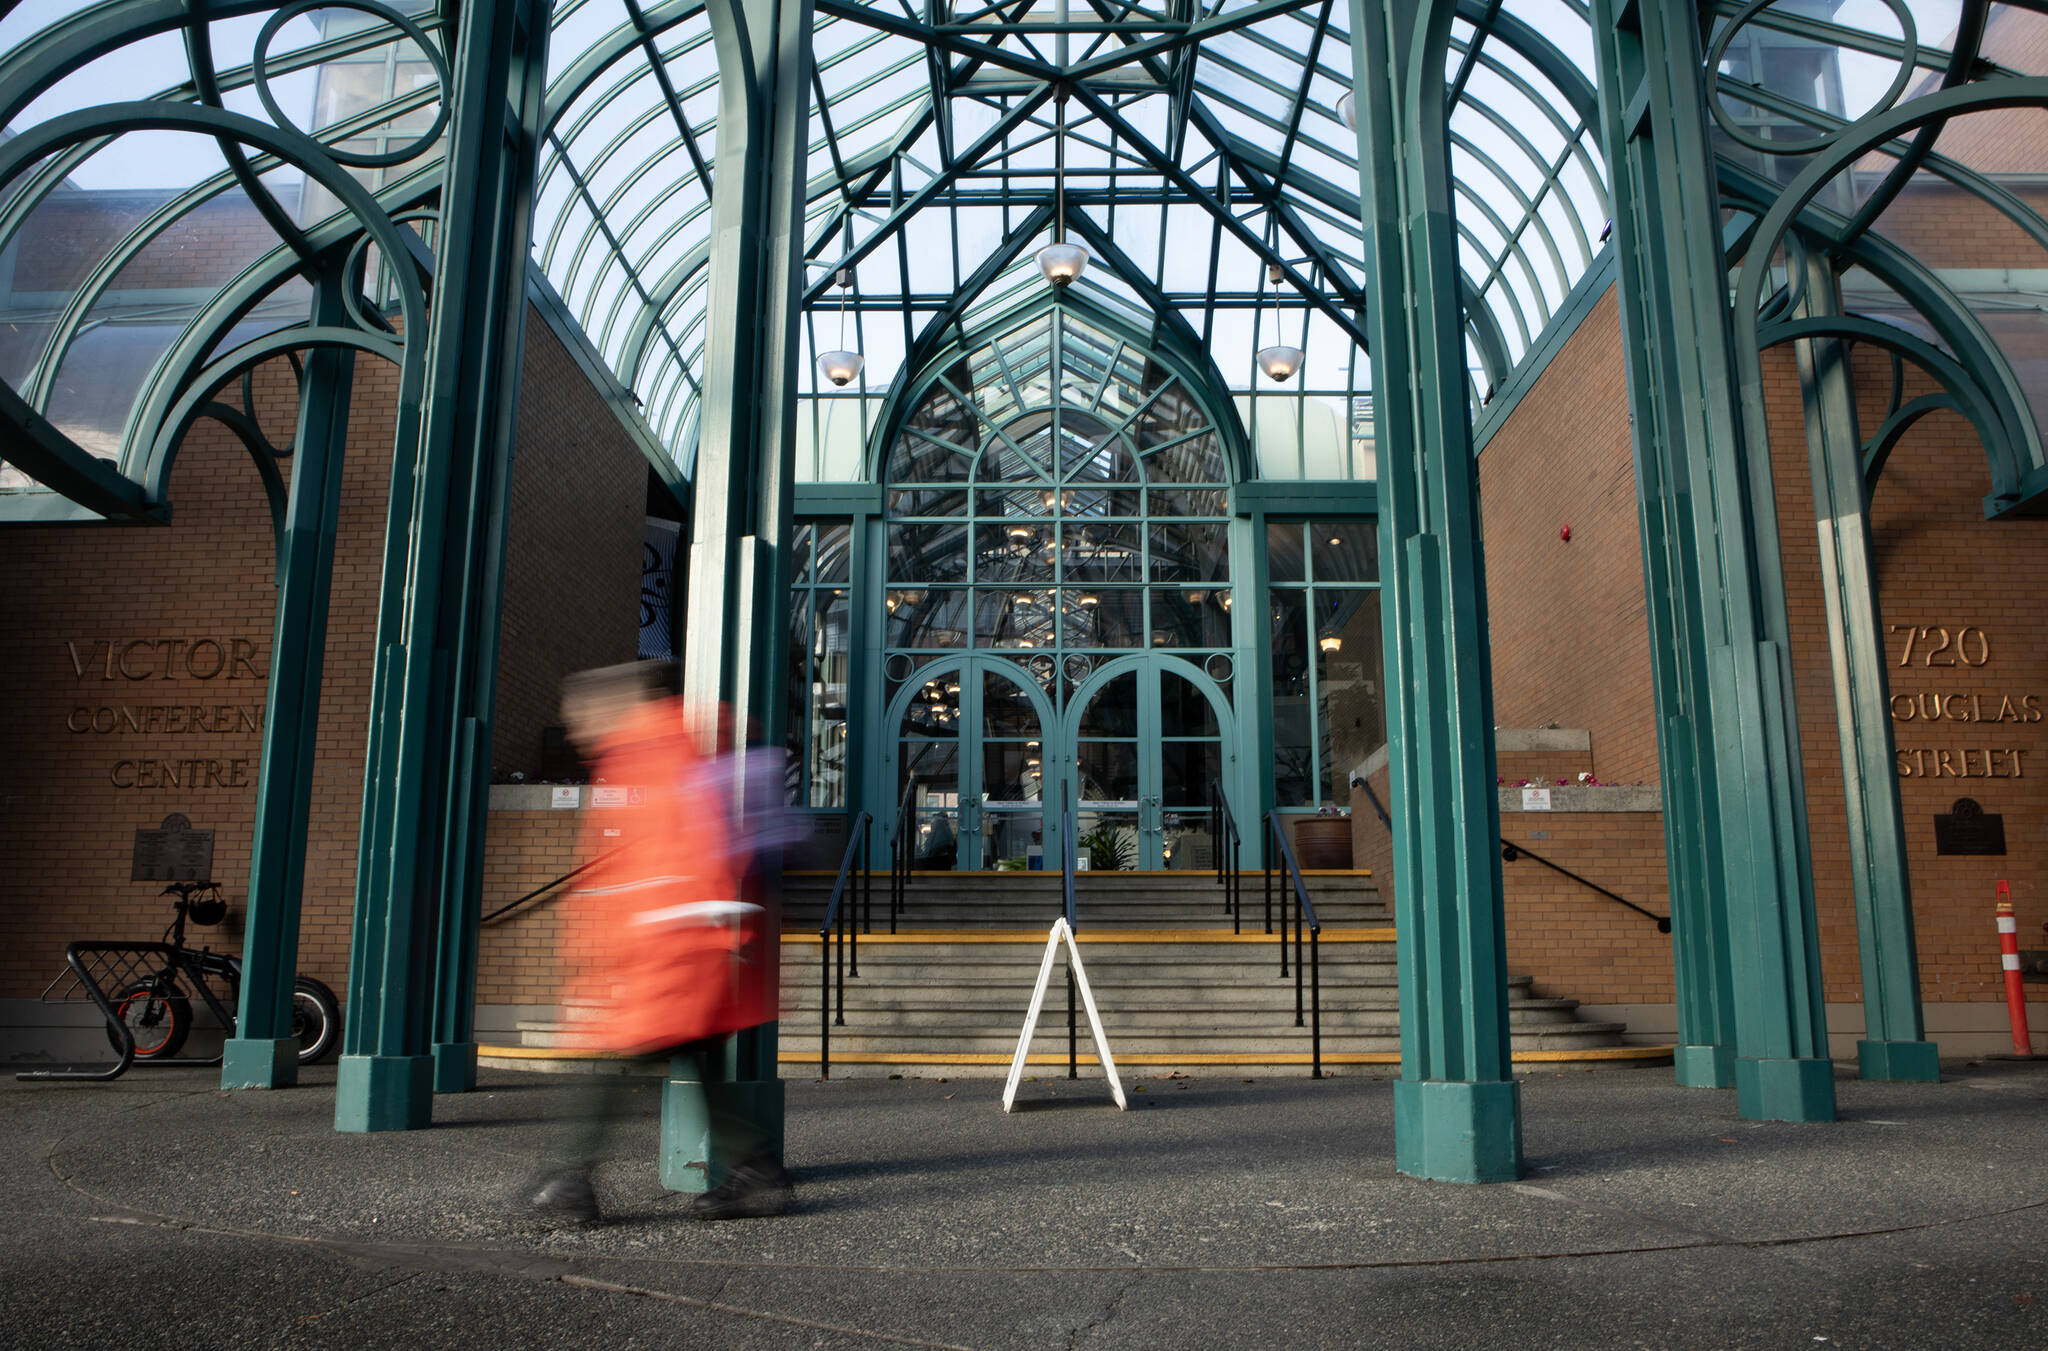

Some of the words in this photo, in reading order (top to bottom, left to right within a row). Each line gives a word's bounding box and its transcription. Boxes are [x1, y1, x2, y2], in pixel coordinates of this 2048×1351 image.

[66, 638, 269, 681] VICTOR
[1891, 625, 1990, 667] 720
[67, 706, 265, 734] CONFEREN
[1891, 694, 2043, 723] OUGLAS
[111, 759, 249, 788] CENTRE
[1895, 750, 2027, 778] STREET
